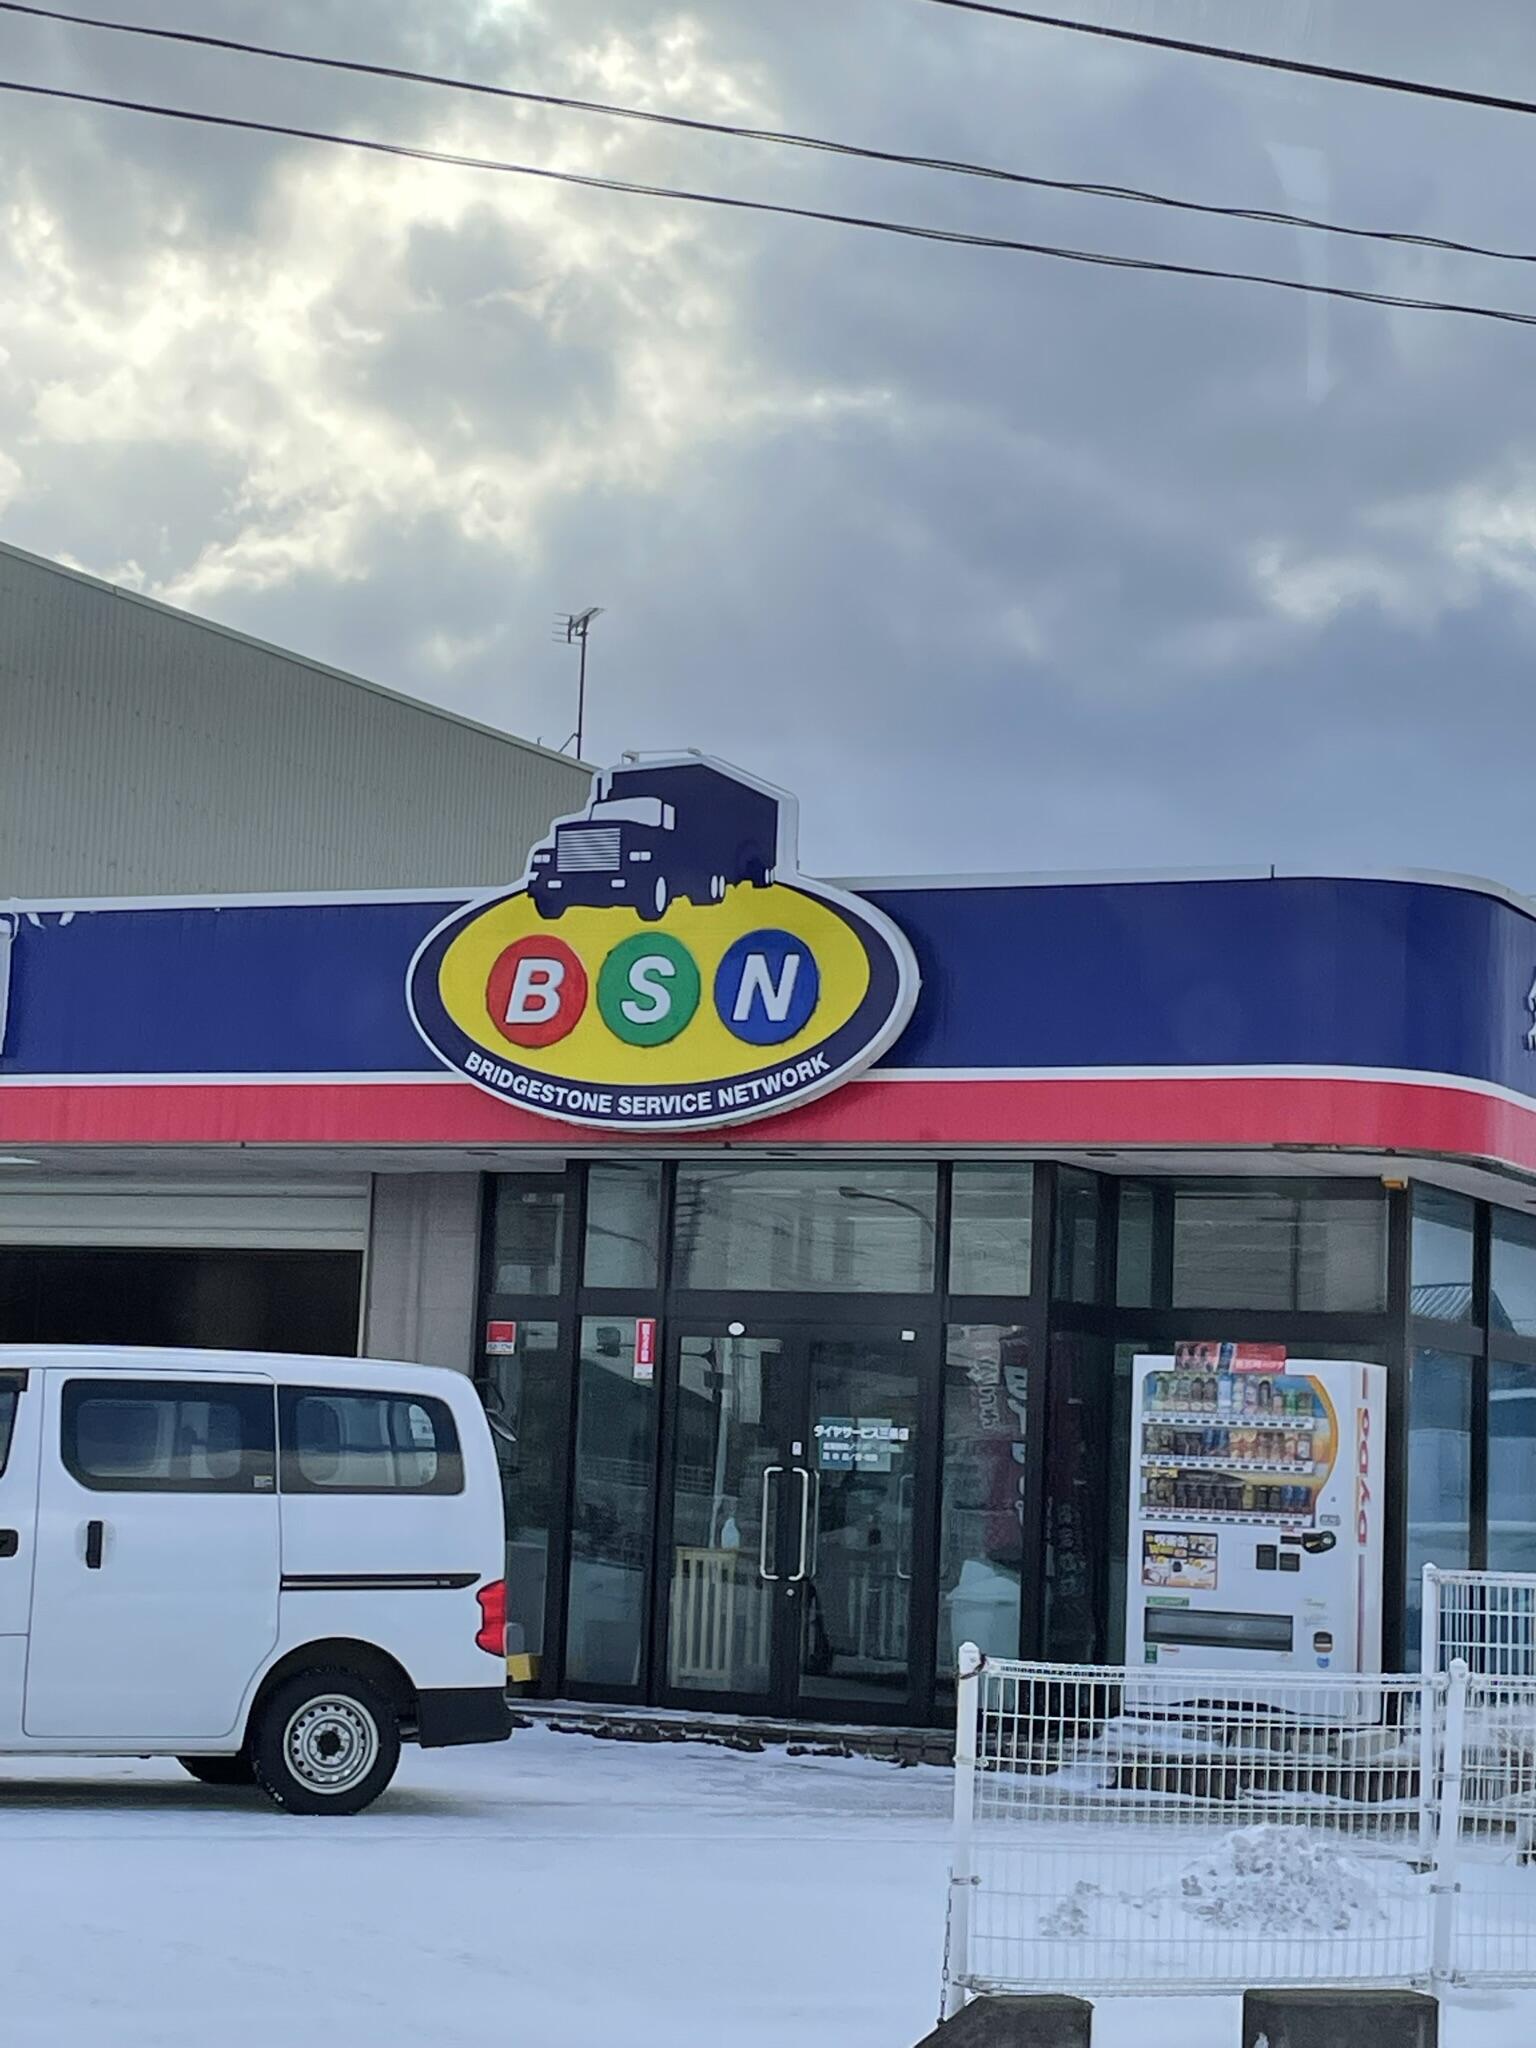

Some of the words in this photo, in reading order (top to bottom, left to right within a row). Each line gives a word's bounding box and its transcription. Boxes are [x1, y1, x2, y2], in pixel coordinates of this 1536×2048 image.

[465, 1051, 612, 1114] BRIDGESTONE
[617, 1091, 712, 1116] SERVICE
[718, 1052, 832, 1104] NETWORK
